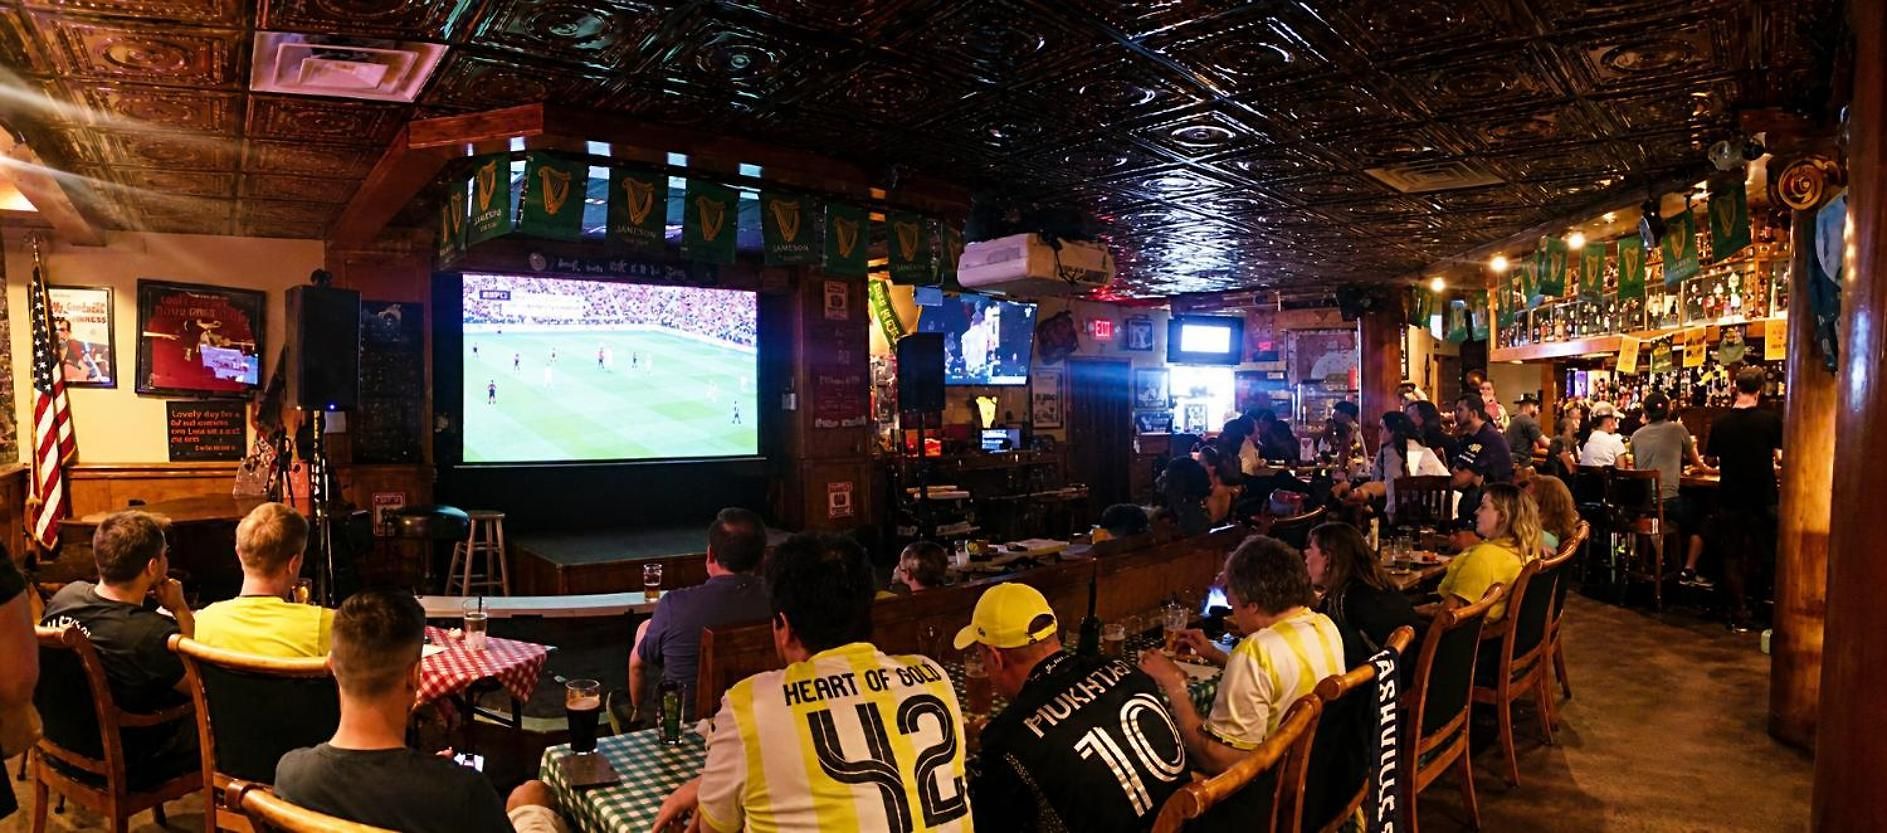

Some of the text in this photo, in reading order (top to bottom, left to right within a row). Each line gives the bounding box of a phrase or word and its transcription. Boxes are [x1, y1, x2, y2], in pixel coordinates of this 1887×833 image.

[783, 663, 942, 706] HEART OF GOLD
[806, 693, 969, 833] 42
[1074, 692, 1186, 818] 10
